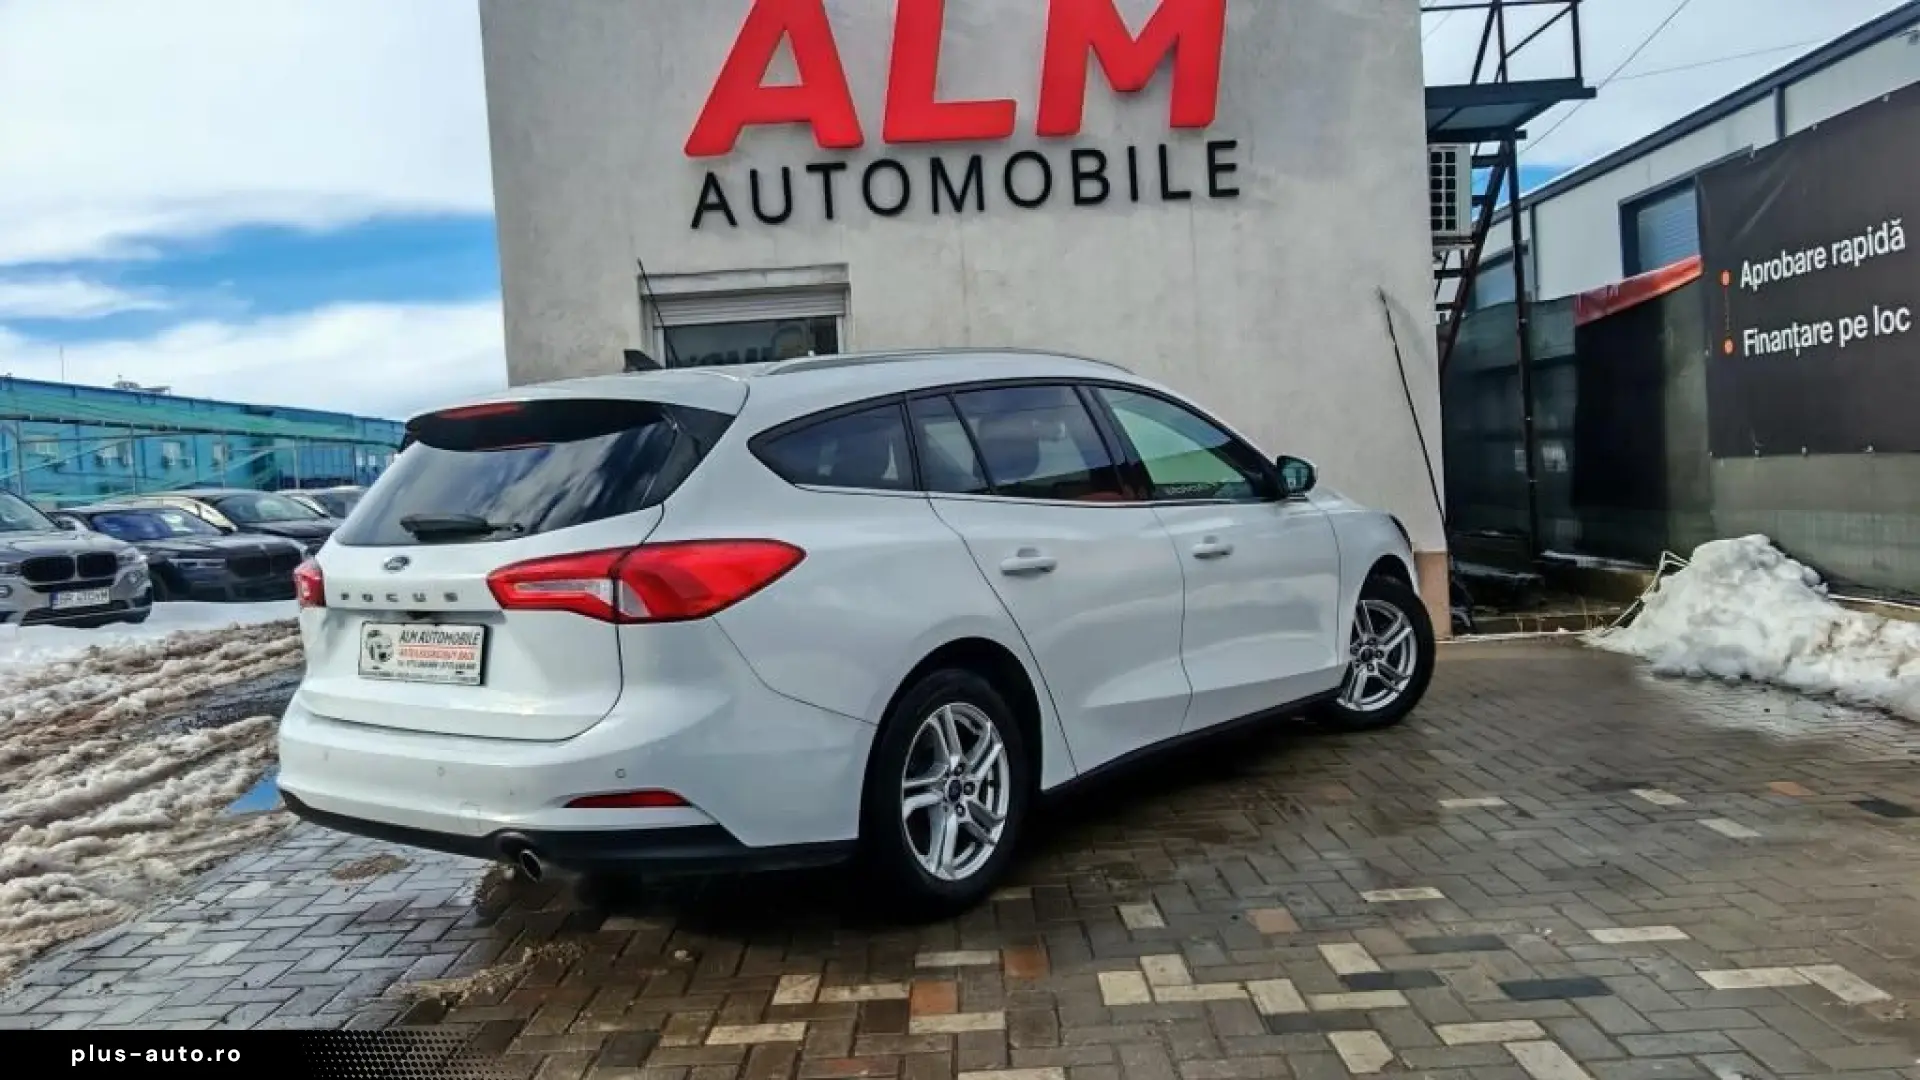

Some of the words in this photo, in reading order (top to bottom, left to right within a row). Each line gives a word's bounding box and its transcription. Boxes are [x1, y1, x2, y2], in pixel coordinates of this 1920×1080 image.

[684, 0, 1227, 157] ALM
[691, 140, 1240, 229] AUTOMOBILE
[1740, 246, 1827, 292] Aprobare
[1831, 218, 1906, 267] rapidă
[1742, 321, 1834, 357] Finanțare
[1838, 314, 1869, 348] pe
[1872, 304, 1911, 337] loc
[340, 592, 458, 603] FOCUS
